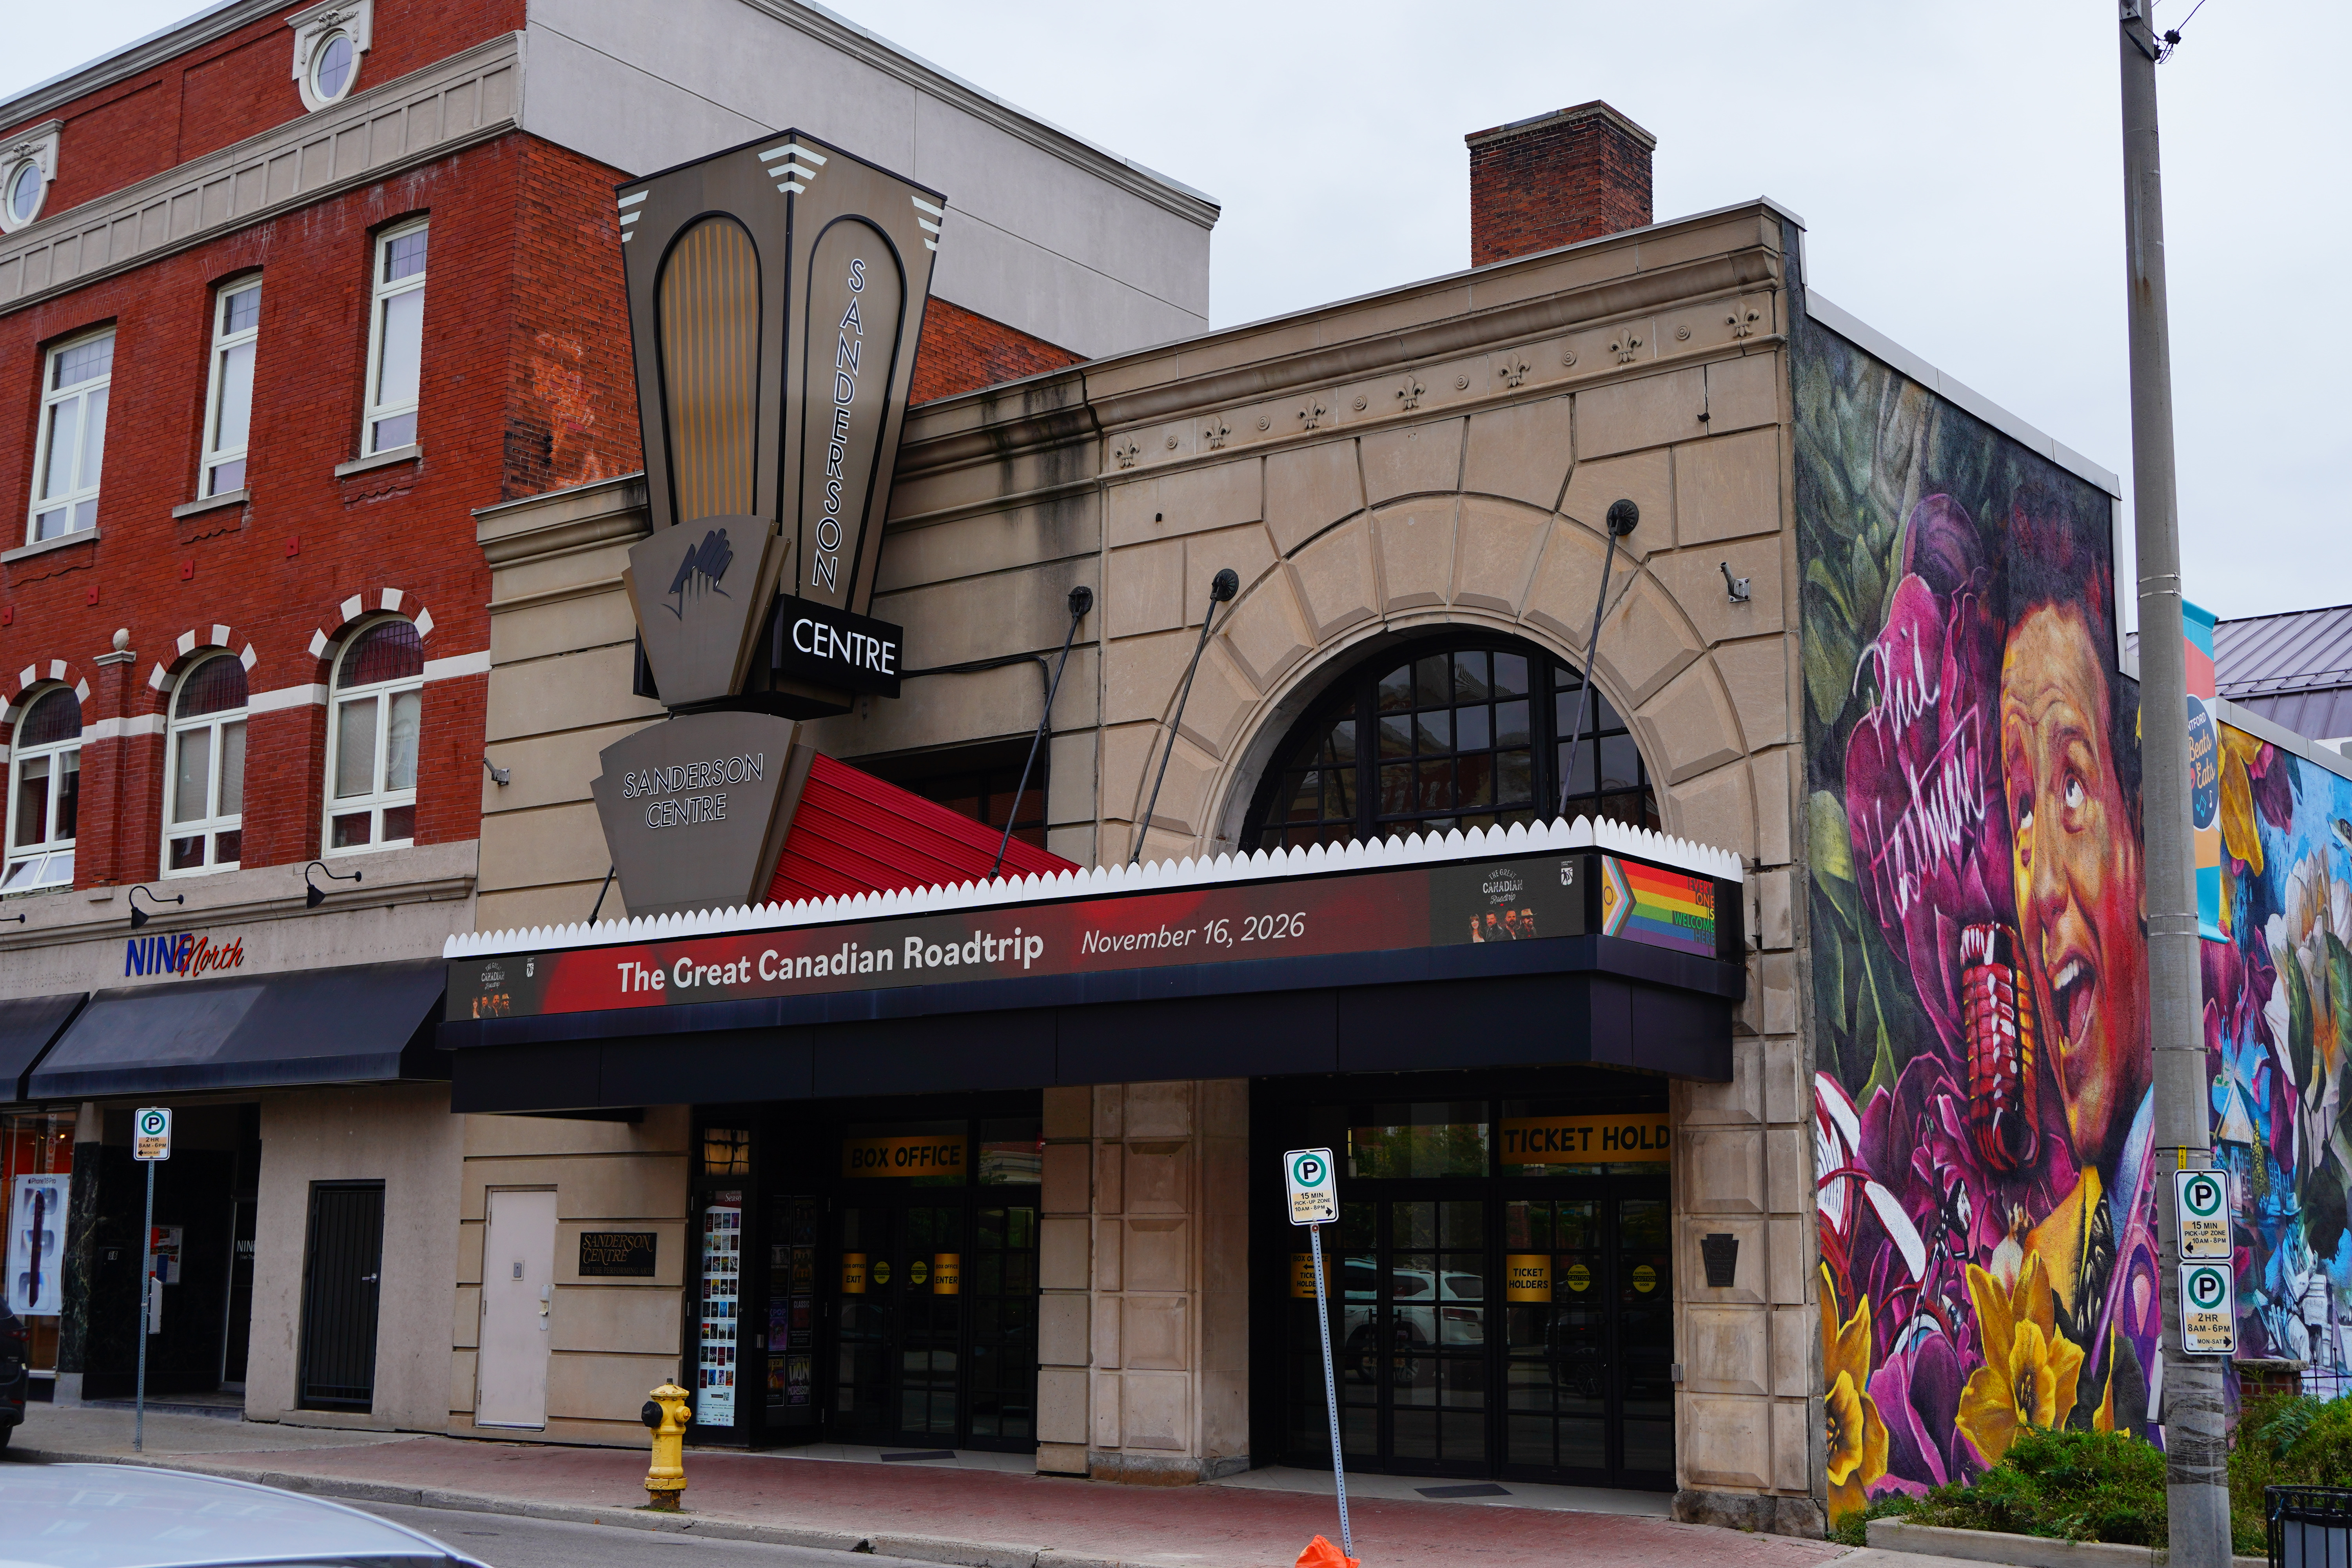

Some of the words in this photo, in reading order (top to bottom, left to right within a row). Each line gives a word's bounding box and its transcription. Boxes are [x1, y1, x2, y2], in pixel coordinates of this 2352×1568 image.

[811, 258, 866, 594] SANDERSON
[793, 618, 896, 676] CENTRE
[2188, 712, 2206, 732] NTFORD
[2189, 729, 2212, 763] Beats
[623, 752, 764, 799] SANDERSON
[2196, 758, 2215, 789] Eats
[646, 793, 727, 829] CENTRE
[1488, 870, 1499, 880] THE
[1499, 869, 1517, 879] GREAT
[1483, 879, 1523, 893] CANADIAN
[1689, 877, 1713, 895] EVERY
[1490, 892, 1516, 904] Roadtrip
[1697, 892, 1715, 908] ONE
[1674, 911, 1715, 933] WELCOME
[1707, 907, 1715, 920] IS
[1082, 924, 1196, 954] November
[1203, 919, 1234, 948] 16,
[1241, 912, 1306, 942] 2026
[1695, 929, 1715, 946] HERE
[125, 933, 192, 976] NINE
[172, 935, 244, 976] North
[617, 962, 665, 993] The
[673, 956, 751, 988] Great
[759, 942, 893, 982] Canadian
[904, 927, 1044, 969] Roadtrip
[149, 1117, 160, 1129] P
[1504, 1127, 1593, 1153] TICKET
[1602, 1125, 1670, 1151] HOLD
[852, 1147, 889, 1169] BOX
[895, 1145, 961, 1167] OFFICE
[1303, 1161, 1318, 1180] P
[2195, 1185, 2212, 1206] P
[583, 1235, 653, 1252] SANDERSON
[583, 1248, 629, 1265] CENTRE
[1513, 1268, 1544, 1277] TICKET
[1509, 1280, 1548, 1289] HOLDERS
[2200, 1277, 2216, 1299] P
[789, 1361, 809, 1383] VAN
